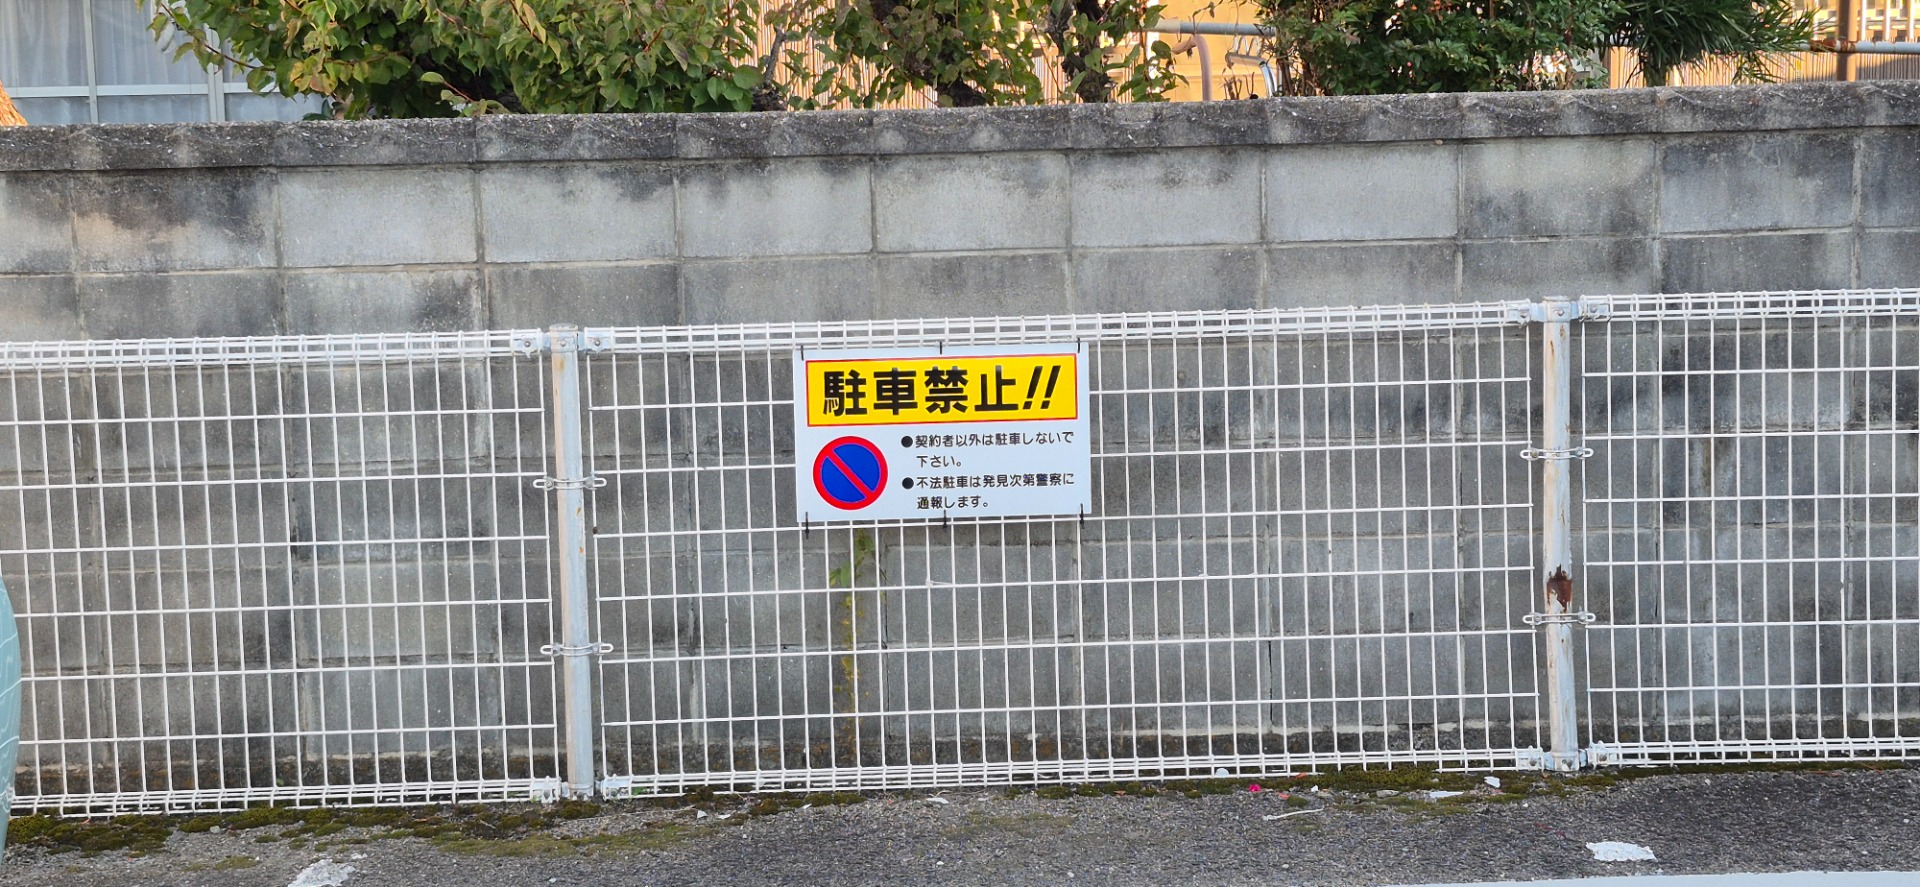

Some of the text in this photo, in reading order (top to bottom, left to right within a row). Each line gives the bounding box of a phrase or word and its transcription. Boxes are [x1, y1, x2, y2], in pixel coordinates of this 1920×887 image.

[823, 365, 1061, 417] 駐車禁止!!
[914, 431, 1075, 448] 契約者以外は駐車しないで
[916, 455, 963, 468] 下さい。
[916, 472, 1075, 490] 不法駐車は発見次第警察に
[916, 495, 989, 510] 通報します。
